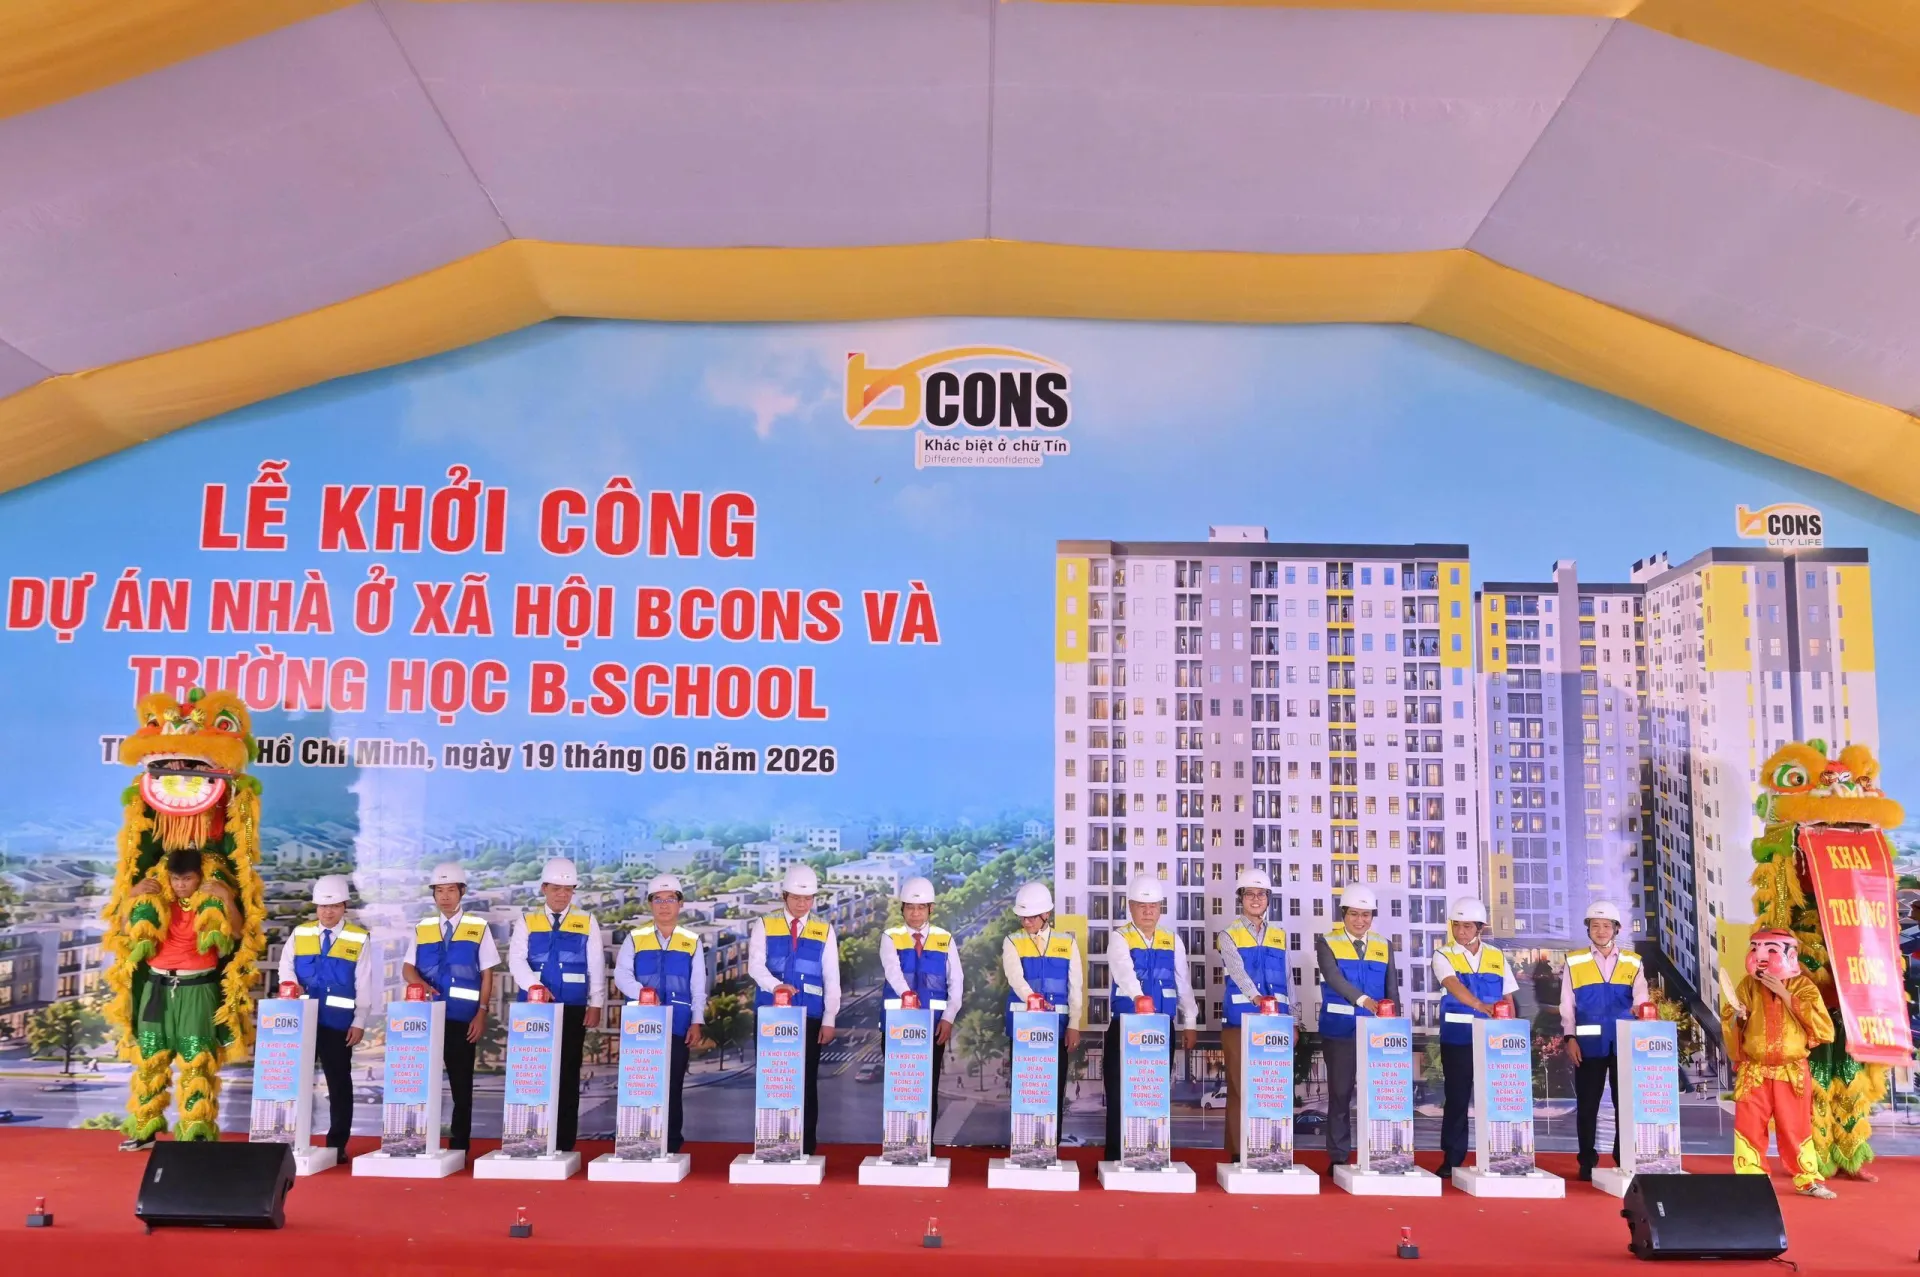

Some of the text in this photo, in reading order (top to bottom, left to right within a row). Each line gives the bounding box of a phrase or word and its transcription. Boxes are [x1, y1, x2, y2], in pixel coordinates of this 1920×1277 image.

[924, 438, 1067, 455] Khác biệt ở chữ Tín
[924, 454, 1040, 464] Difference in confidence
[202, 459, 757, 560] LỄ KHỞI CÔNG
[1768, 538, 1822, 546] CITY LIFE
[9, 565, 940, 648] DỰ ÁN NHÀ Ở XÃ HỘI BCONS VÀ
[390, 660, 508, 725] HỌC
[531, 663, 829, 721] B.SCHOOL
[302, 740, 346, 766] Chí
[357, 740, 434, 768] Minh,
[447, 743, 512, 772] ngày
[524, 744, 555, 769] 19
[564, 744, 642, 776] tháng
[654, 746, 686, 771] 06
[697, 747, 758, 772] năm
[768, 748, 836, 774] 2026
[1826, 845, 1872, 870] KHAI
